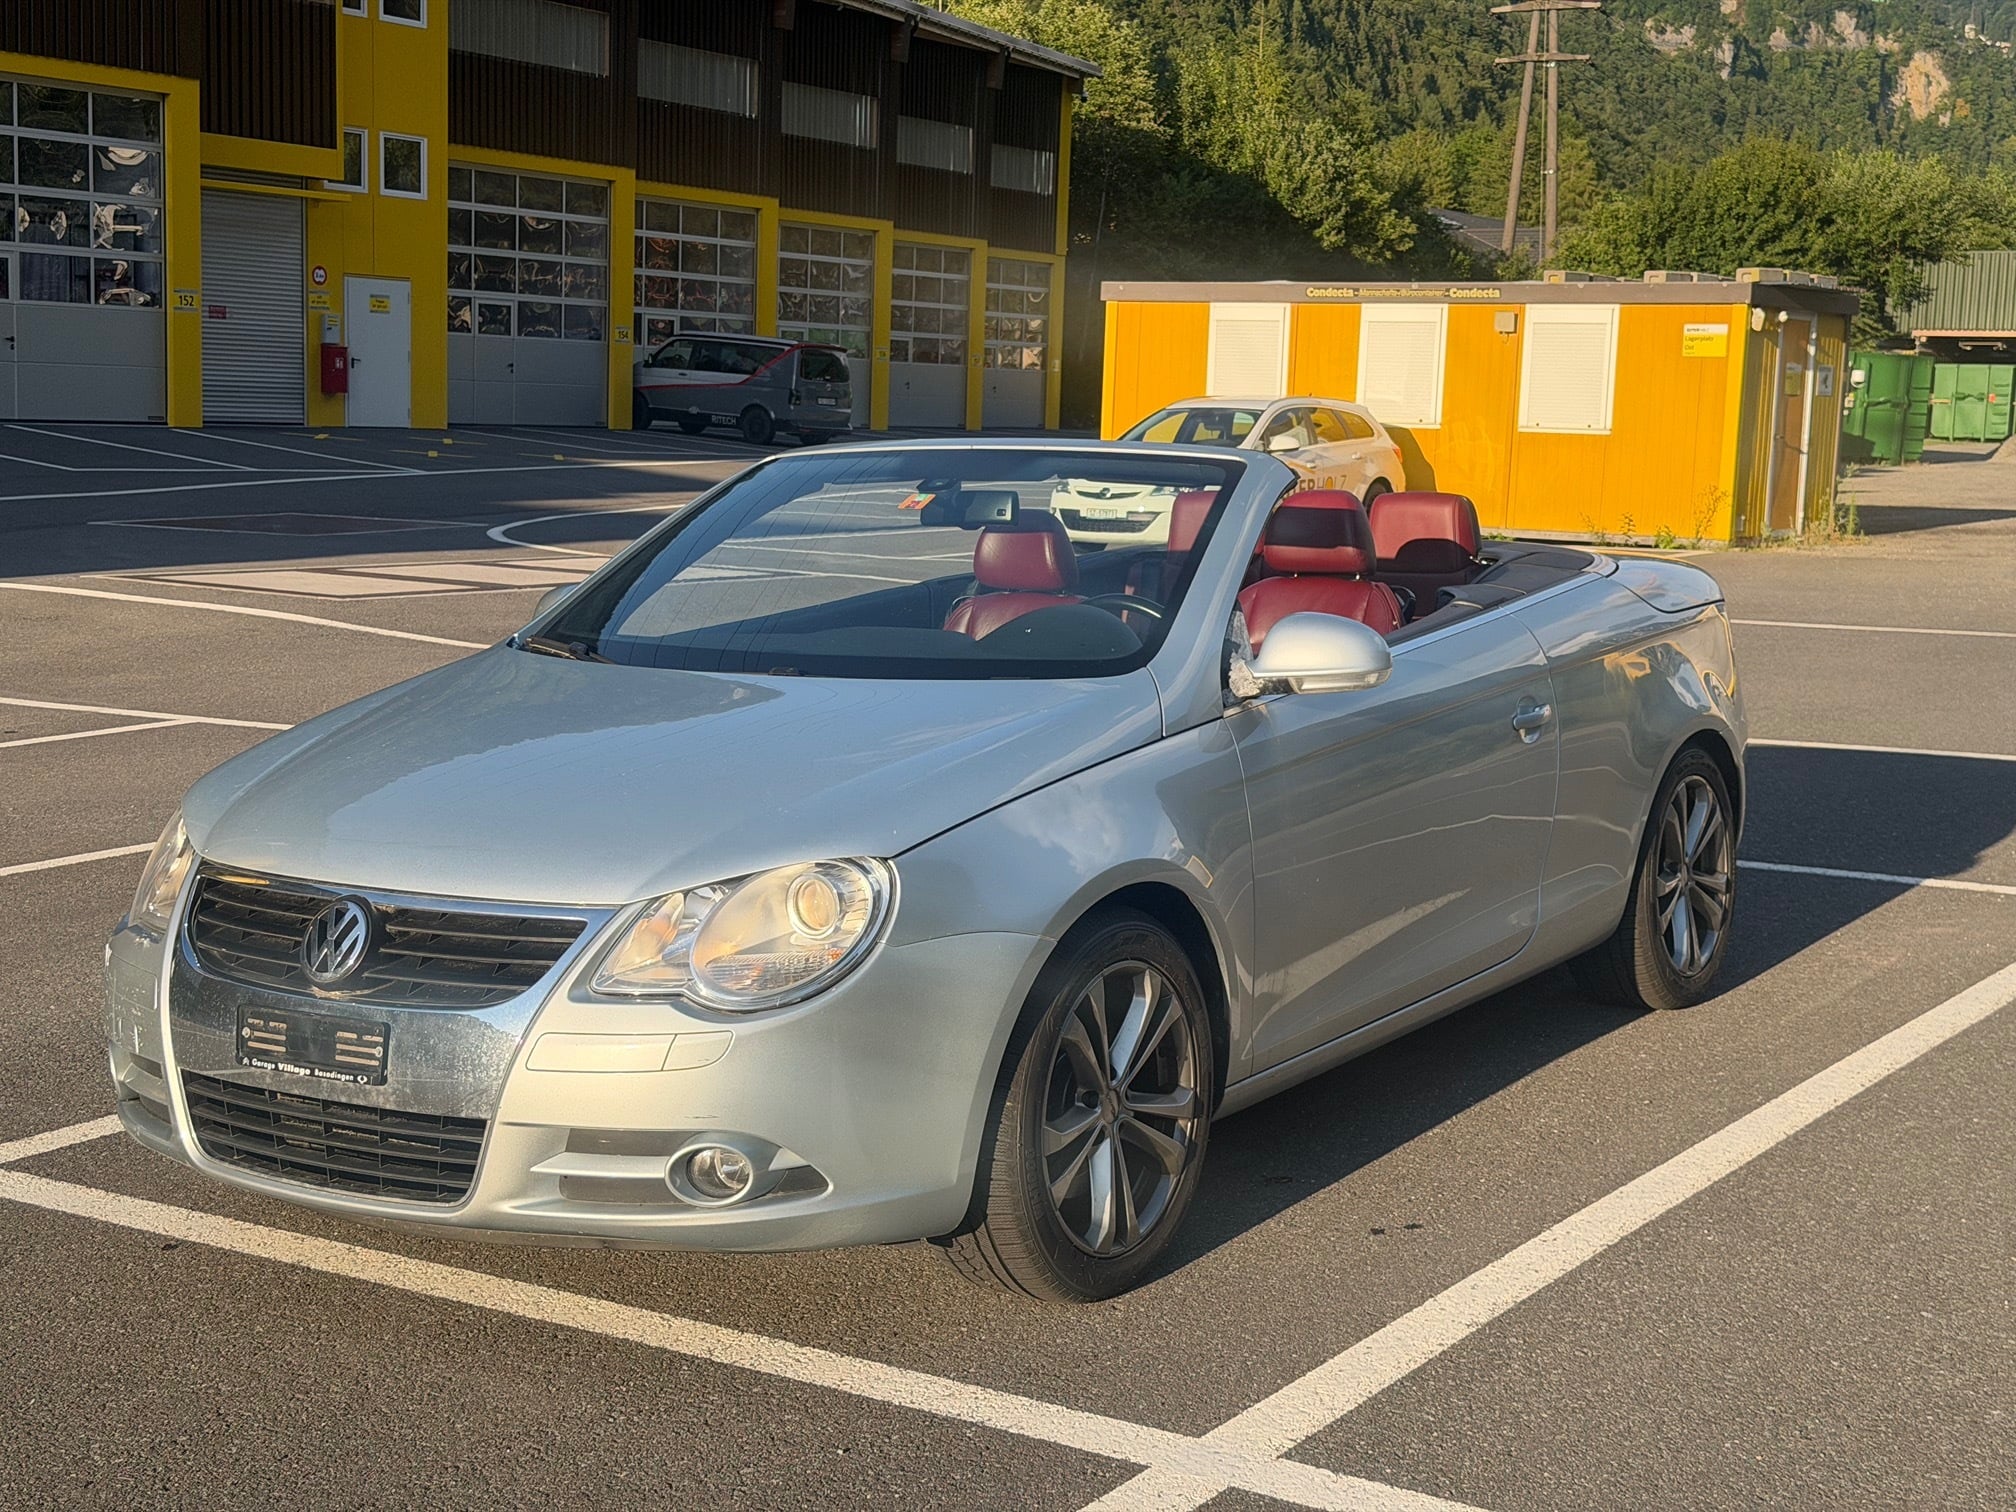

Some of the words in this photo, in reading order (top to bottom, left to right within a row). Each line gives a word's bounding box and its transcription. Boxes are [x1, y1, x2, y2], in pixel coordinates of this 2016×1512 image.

[1306, 287, 1353, 297] Condecta
[1449, 287, 1501, 298] Condecta
[178, 295, 195, 307] 152
[618, 330, 629, 339] 154
[251, 1057, 276, 1071] Garage
[277, 1062, 311, 1076] Village
